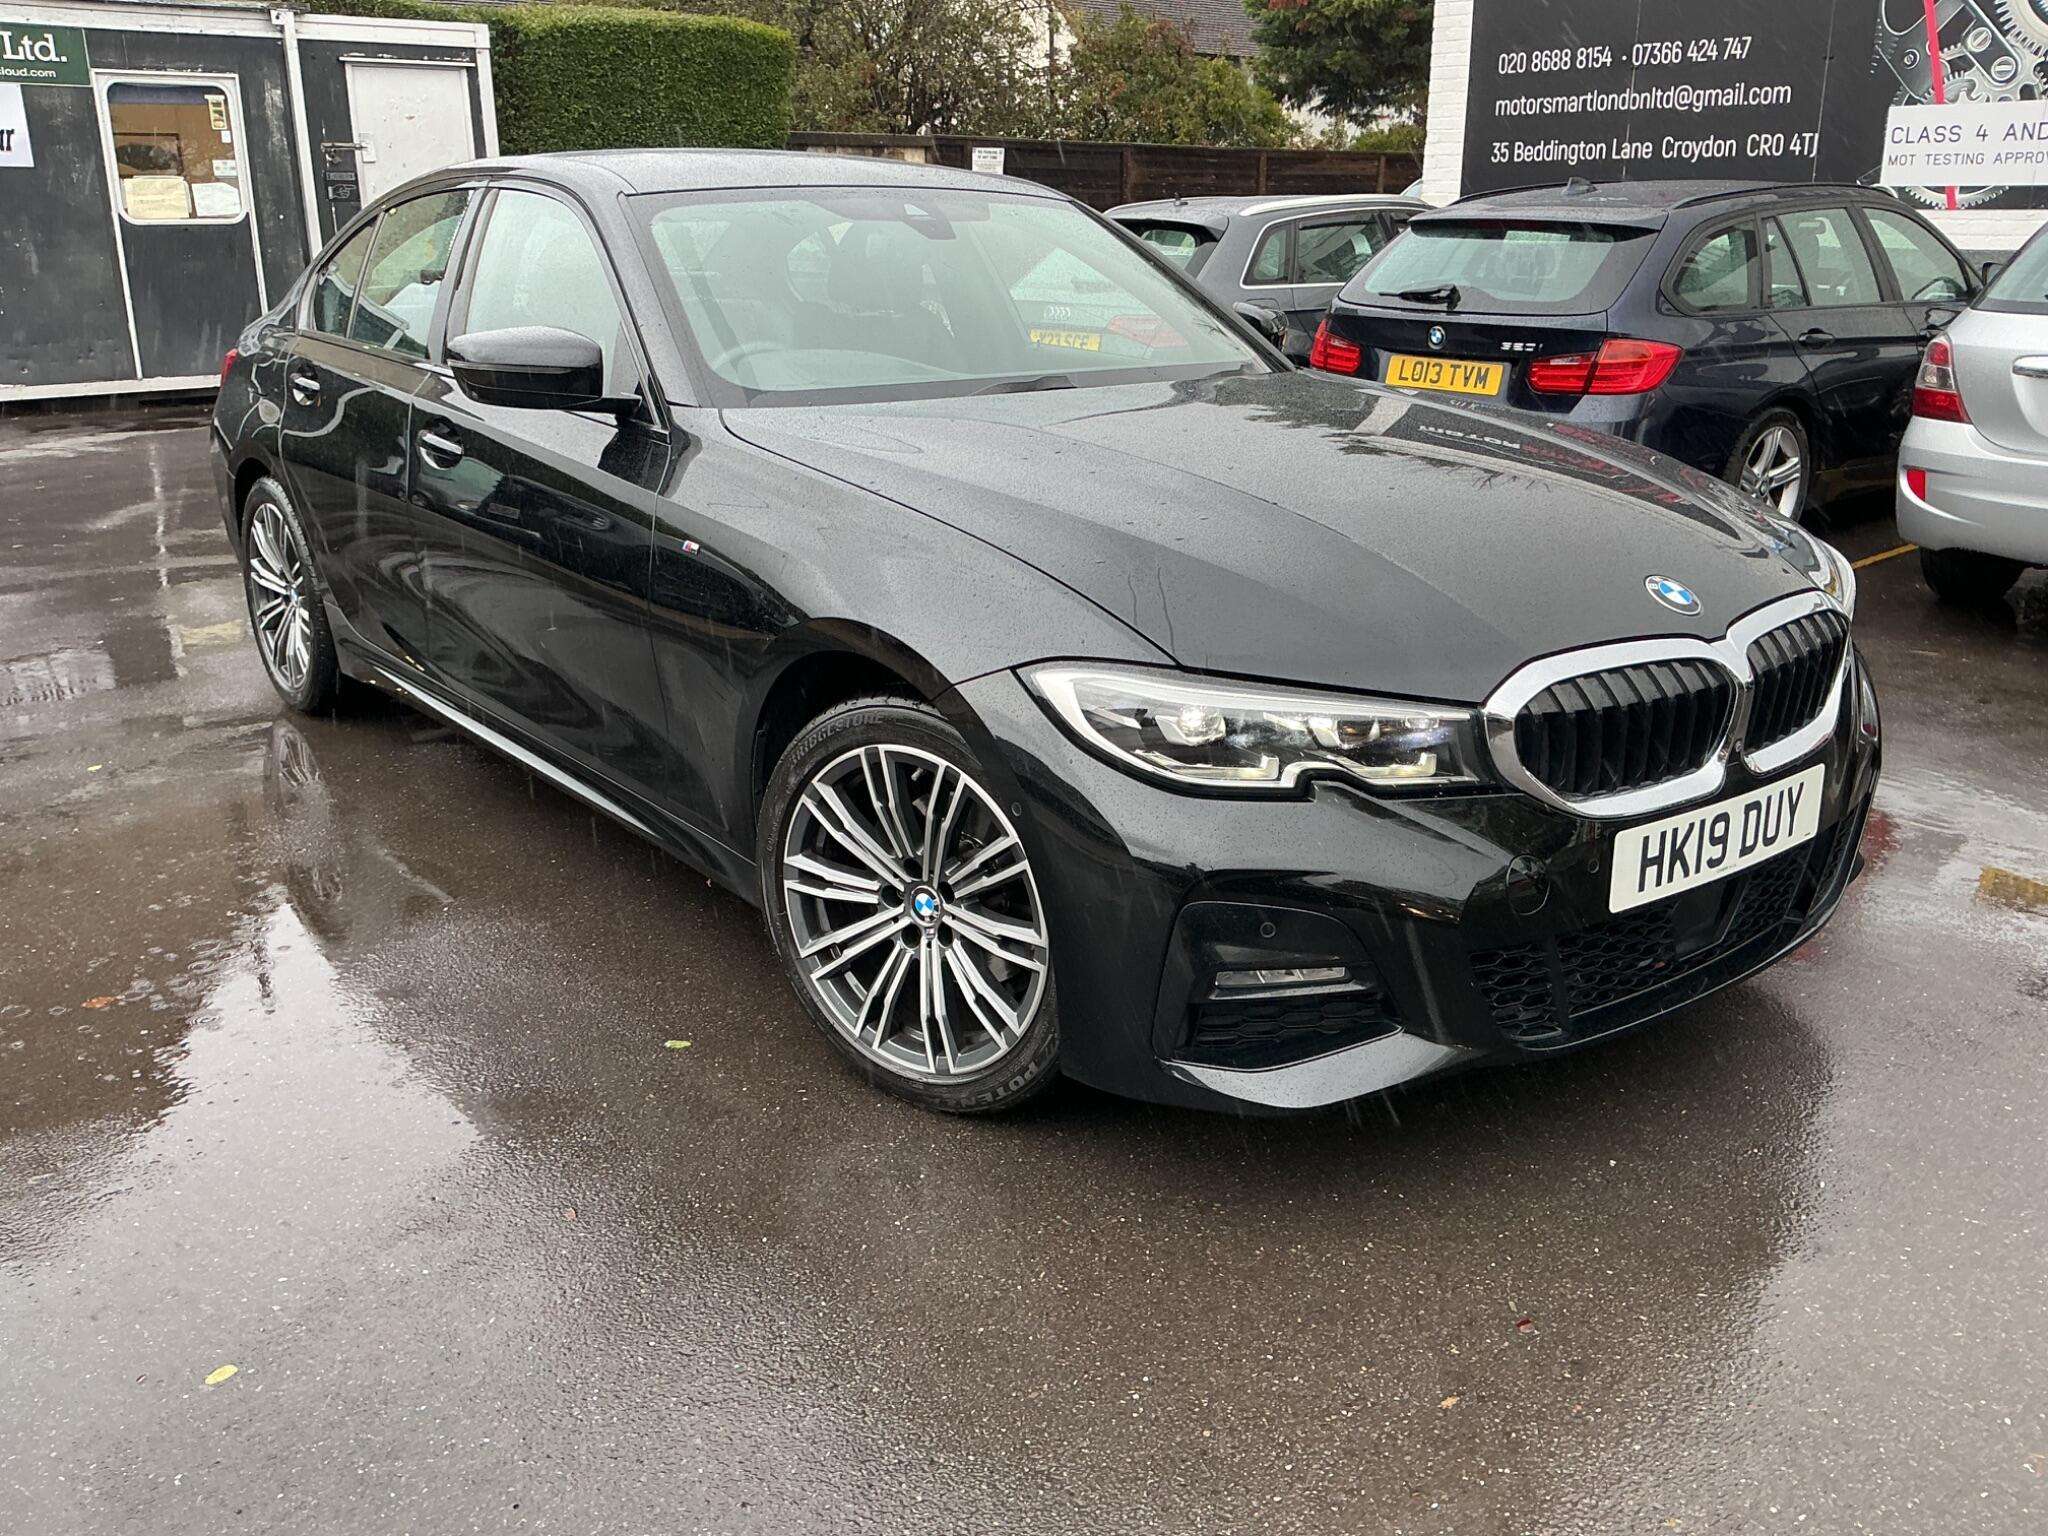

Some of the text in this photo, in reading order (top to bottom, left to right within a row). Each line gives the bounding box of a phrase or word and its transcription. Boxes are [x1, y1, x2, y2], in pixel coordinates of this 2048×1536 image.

[0, 30, 68, 63] Ltd.
[1498, 36, 1752, 75] 020 8688 8154 07366 424 747
[1495, 82, 1792, 116] motorsmartlondonltd@gmail.com
[1491, 142, 1509, 163] 35
[1514, 139, 1606, 166] Beddington
[1612, 138, 1653, 160] Lane
[1662, 134, 1737, 164] Croydon
[1790, 132, 1819, 158] 4TJ
[1891, 121, 2048, 144] CLASS 4 AND
[1888, 151, 2048, 166] MOT TESTING APPRO
[1398, 359, 1491, 389] LO13 TVM
[1637, 781, 1806, 893] HK19 DUY
